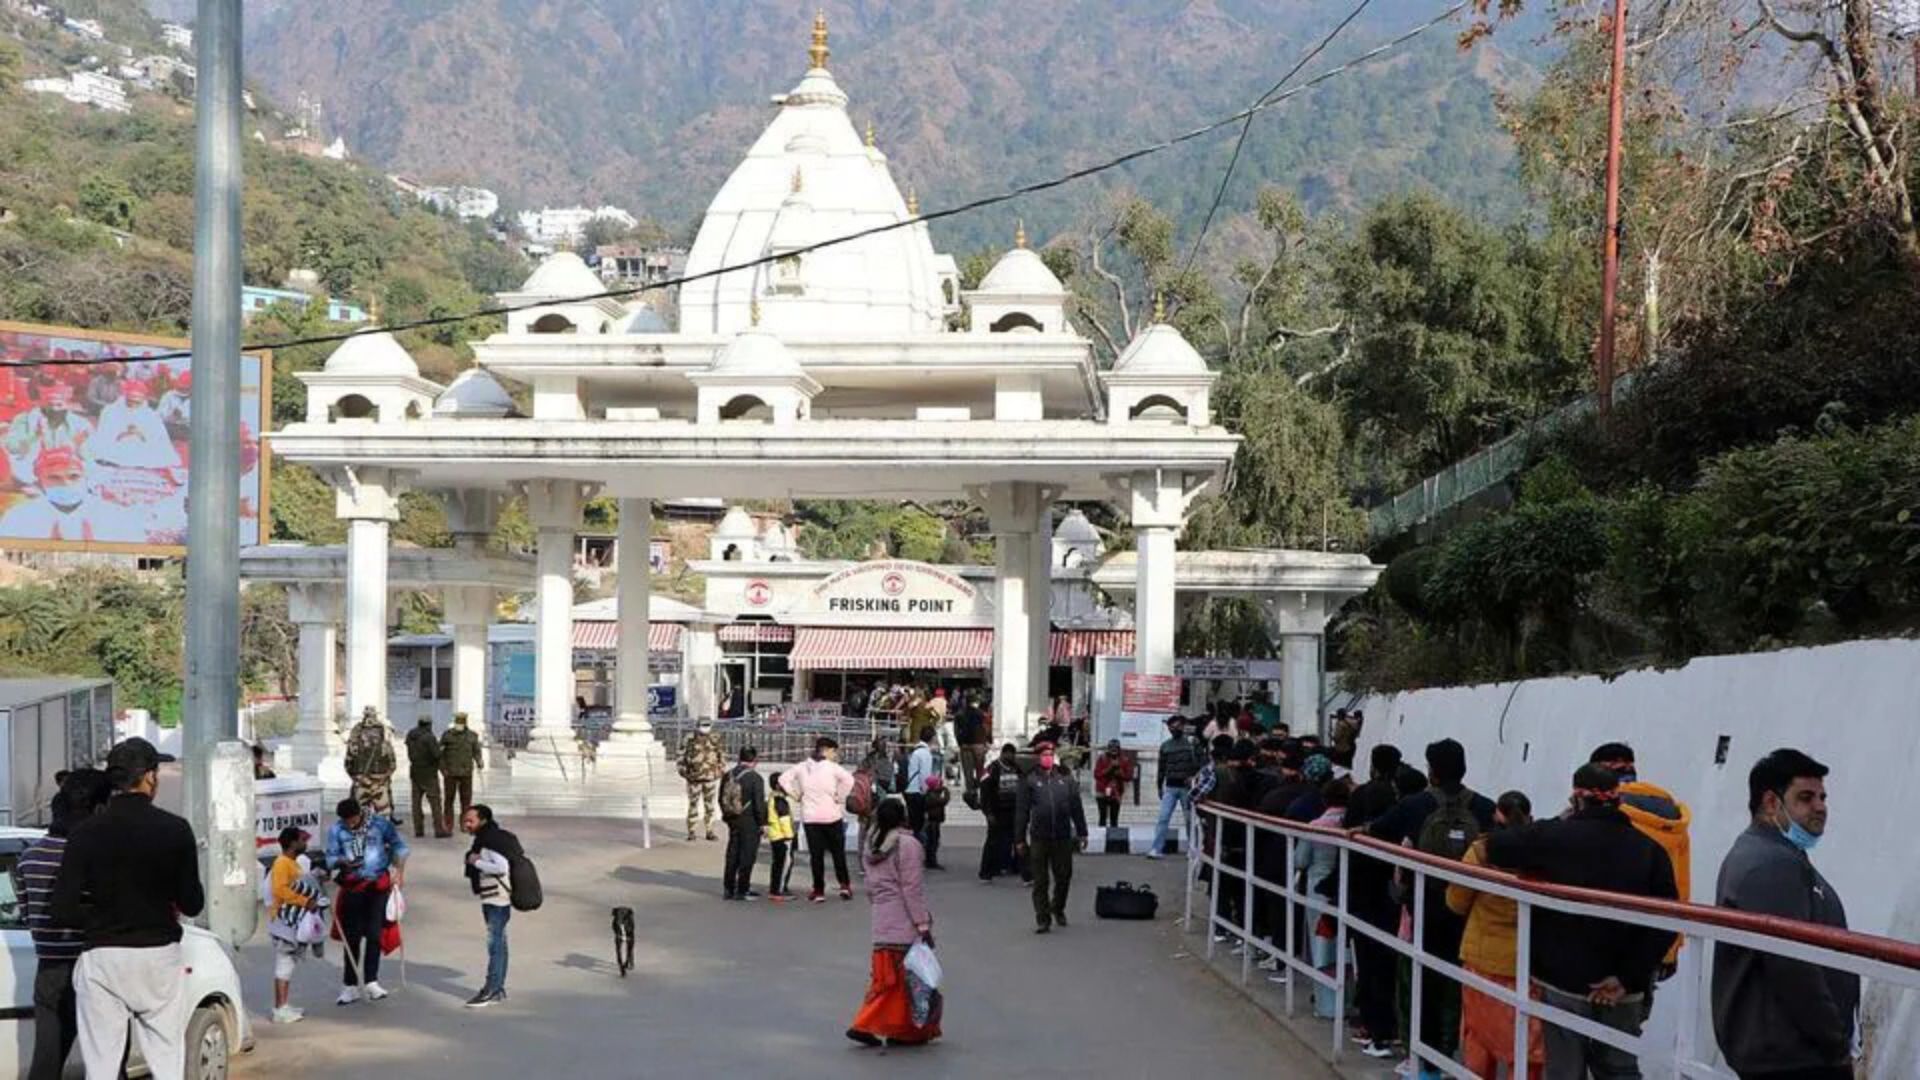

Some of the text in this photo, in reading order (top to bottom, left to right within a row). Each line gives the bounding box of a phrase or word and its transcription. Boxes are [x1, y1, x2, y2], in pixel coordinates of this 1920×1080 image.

[829, 598, 954, 613] FRISKING POINT
[262, 817, 275, 832] TO
